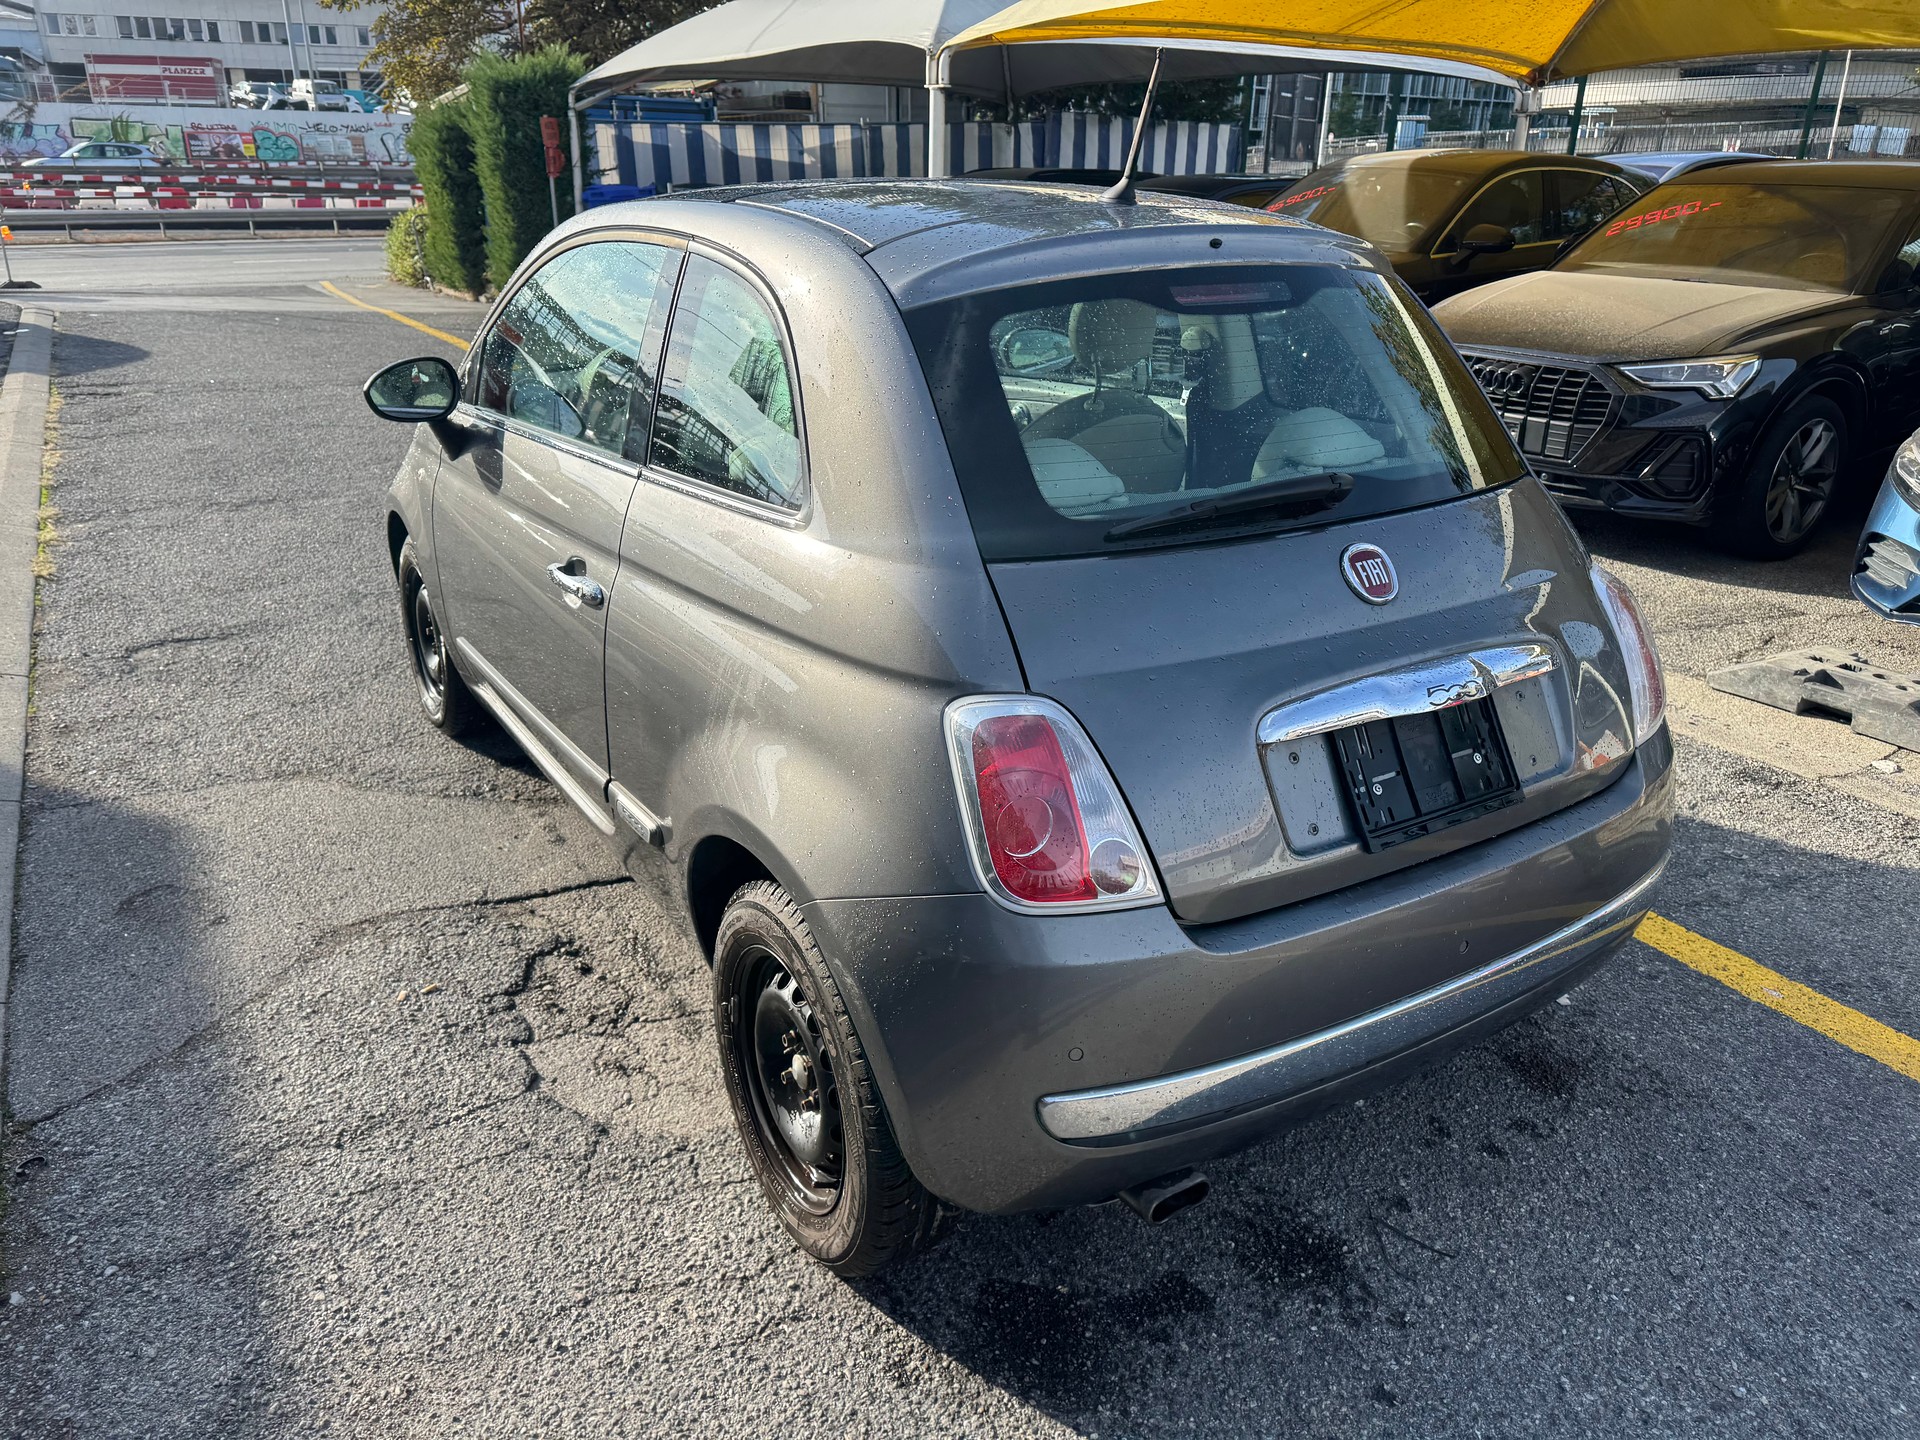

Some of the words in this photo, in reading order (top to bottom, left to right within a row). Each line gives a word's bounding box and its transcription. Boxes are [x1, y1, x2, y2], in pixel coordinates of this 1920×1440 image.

[161, 66, 206, 75] PLANZER
[1355, 558, 1389, 588] FIAT
[1426, 680, 1480, 707] 500
